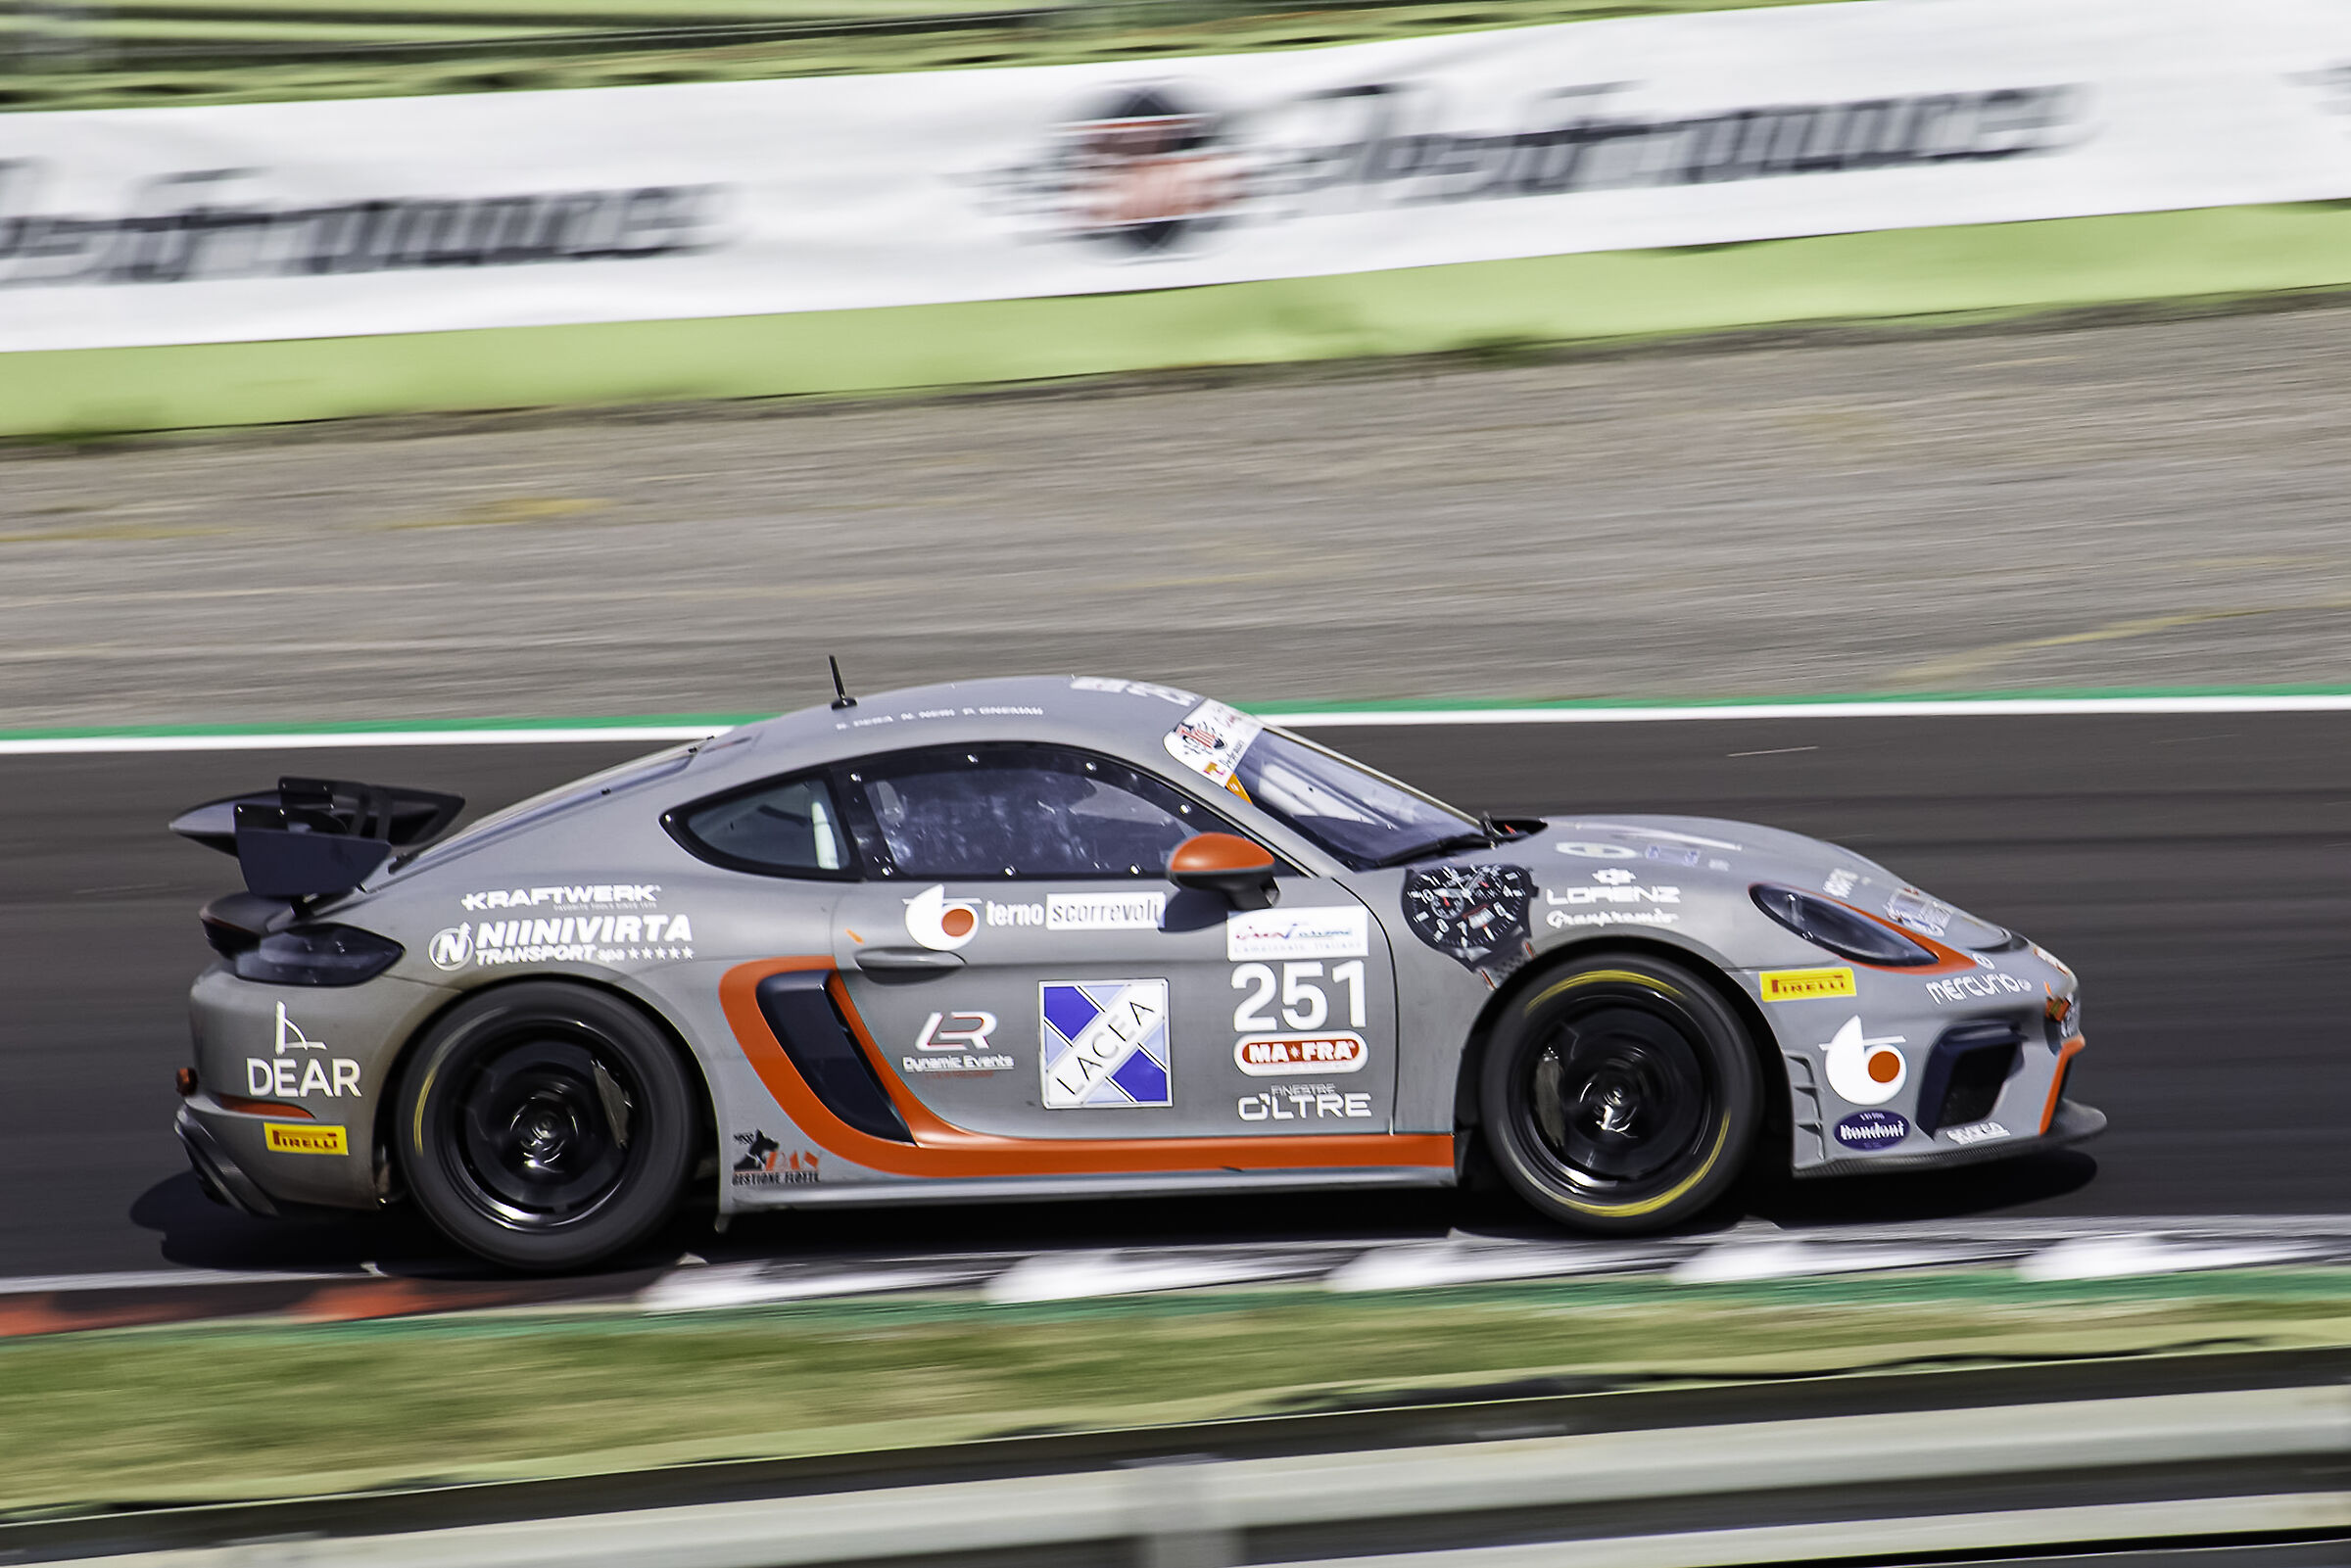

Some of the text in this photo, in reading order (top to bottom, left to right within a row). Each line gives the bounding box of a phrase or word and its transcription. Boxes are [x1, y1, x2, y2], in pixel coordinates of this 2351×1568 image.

[461, 884, 660, 911] KRAFTWERK
[1547, 885, 1681, 906] LORENZ
[986, 899, 1159, 927] terno scorrevoli
[476, 914, 694, 948] NIINIVIRTA
[476, 944, 598, 966] TRANSPORT
[1231, 960, 1367, 1032] 251
[1771, 974, 1844, 993] PIRELLI
[915, 1012, 997, 1051] LR
[1055, 1001, 1155, 1096] LACEA
[247, 1058, 362, 1097] DEAR
[271, 1128, 339, 1150] PIRELLI
